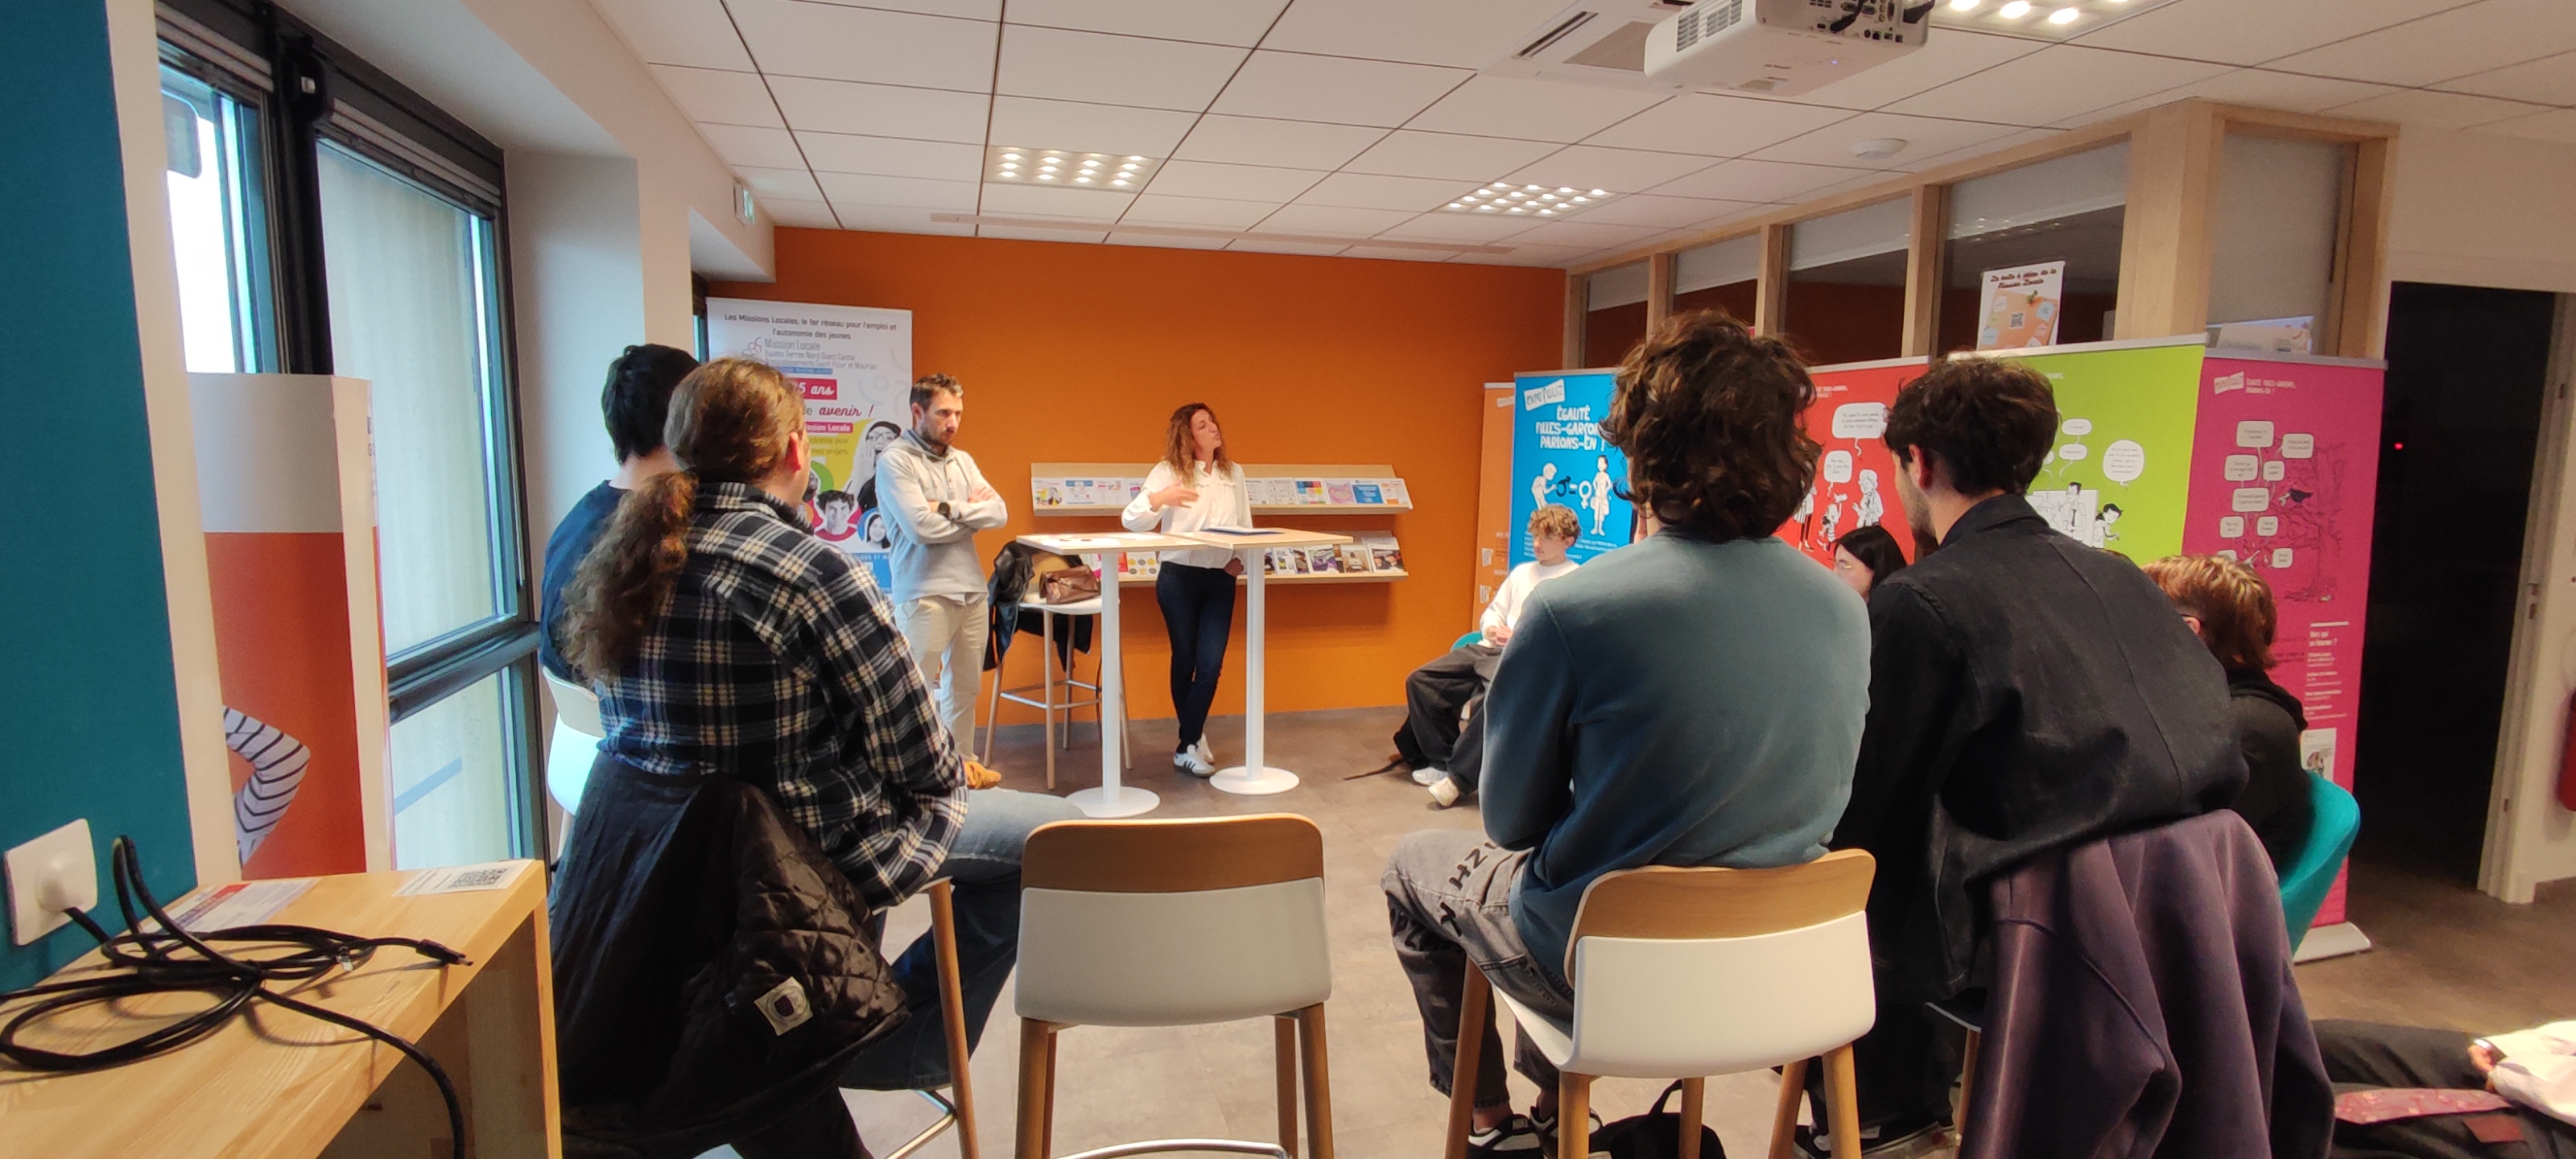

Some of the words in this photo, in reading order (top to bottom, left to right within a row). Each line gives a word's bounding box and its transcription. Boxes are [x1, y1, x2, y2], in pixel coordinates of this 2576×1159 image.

[724, 313, 737, 321] Les
[810, 385, 835, 395] ans
[819, 405, 862, 417] avenir
[1556, 403, 1591, 422] ÉGALITÉ
